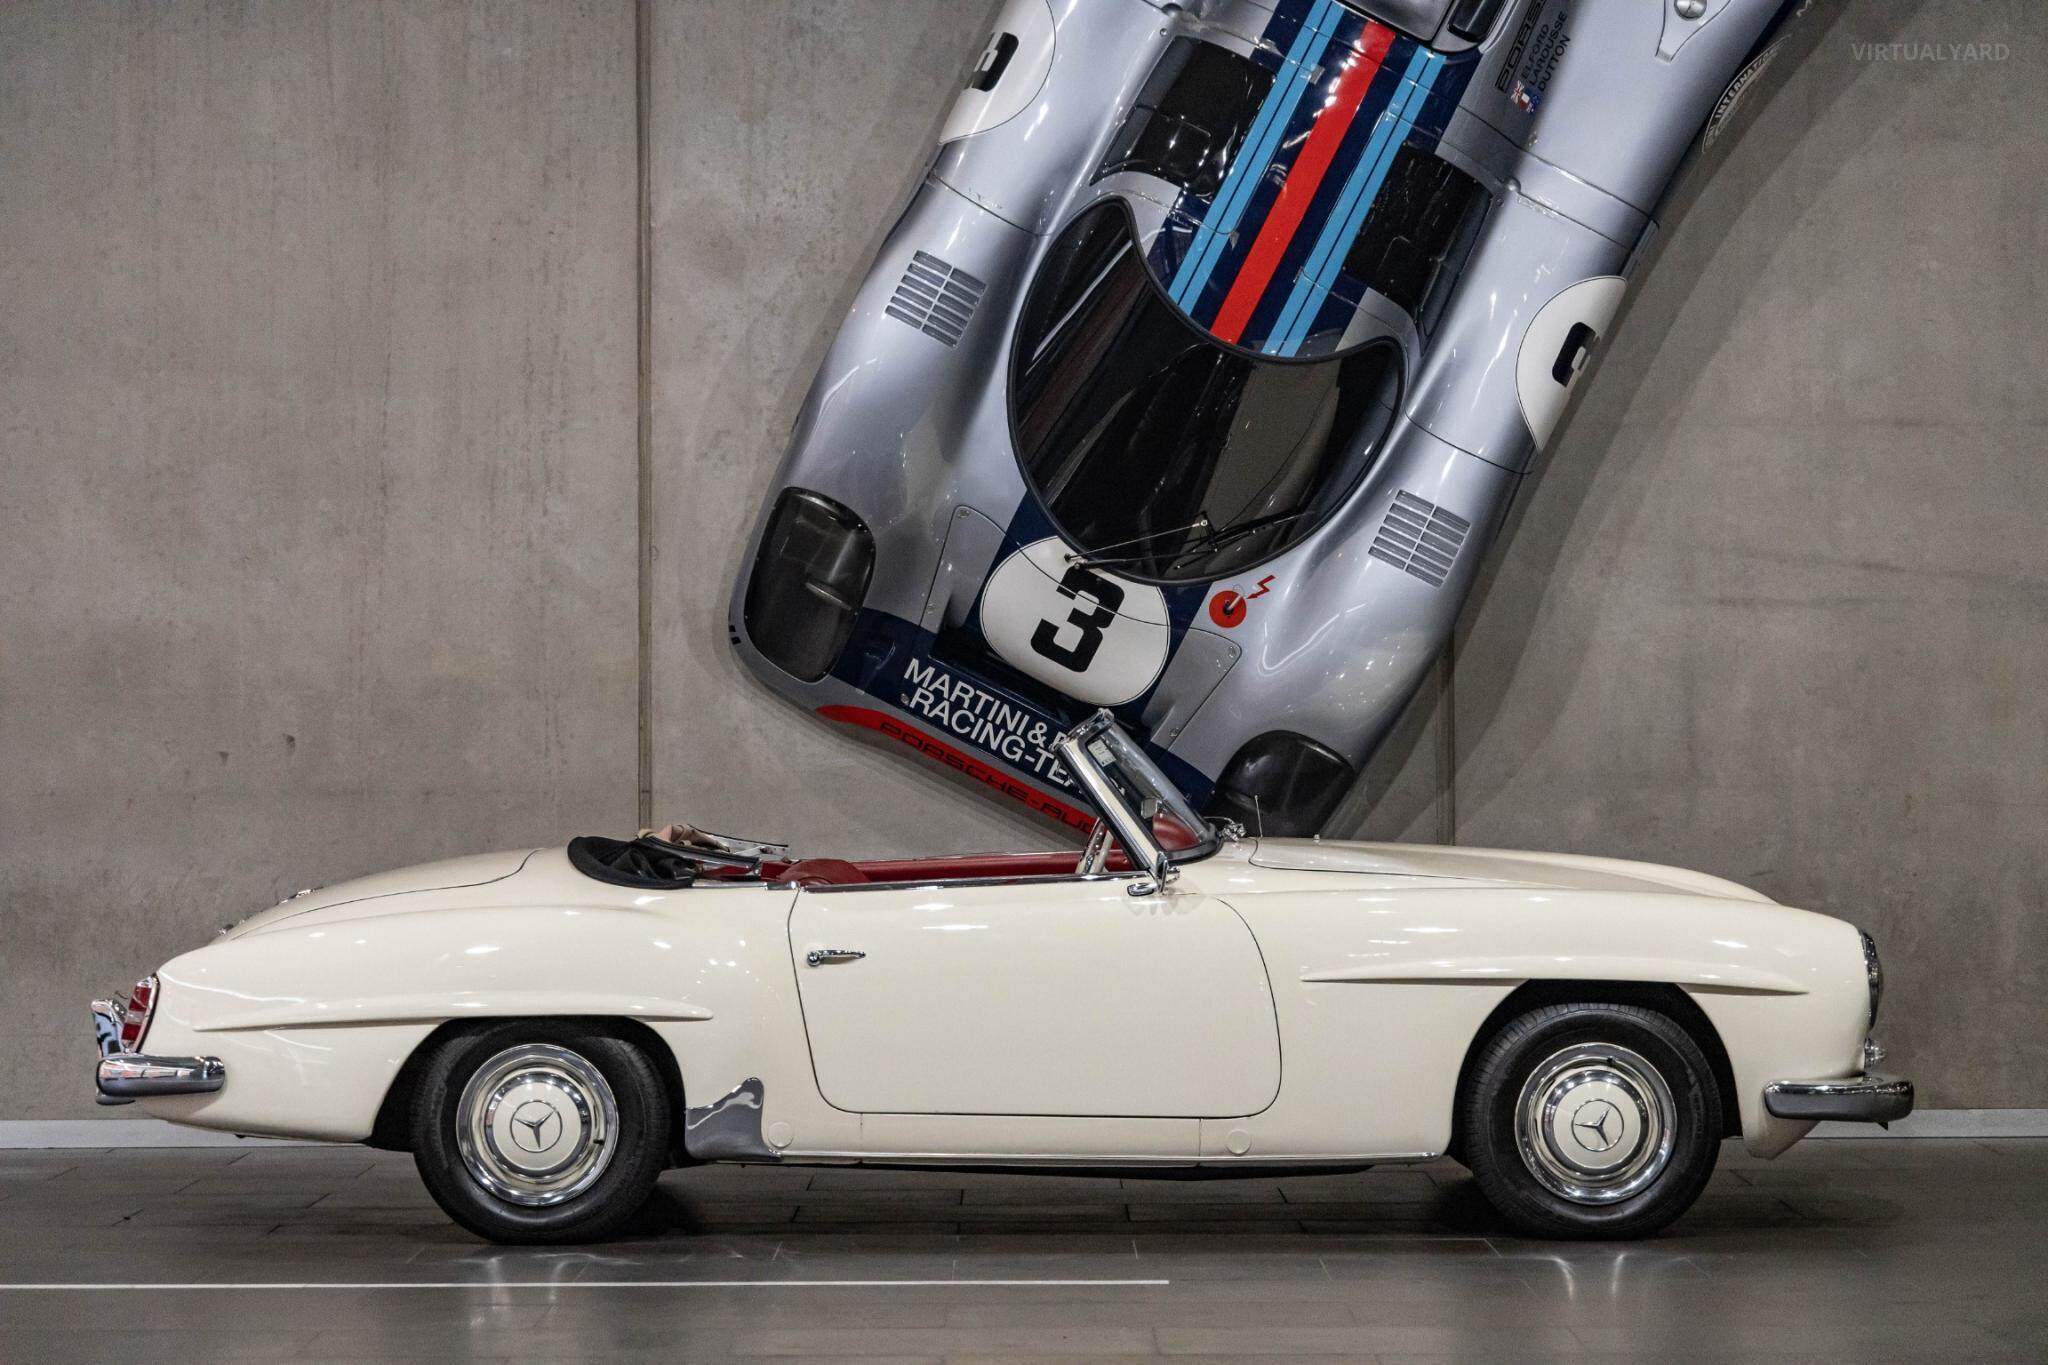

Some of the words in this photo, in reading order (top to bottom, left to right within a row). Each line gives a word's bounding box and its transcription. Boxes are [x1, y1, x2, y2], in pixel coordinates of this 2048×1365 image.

[1496, 0, 1543, 93] PORS
[1521, 23, 1550, 80] ELFORD
[1528, 11, 1568, 87] LAROUSSE
[1537, 34, 1571, 92] DUTTON
[1030, 564, 1125, 673] 3
[903, 657, 1030, 736] MARTINI
[909, 687, 1074, 787] RACING-TE
[880, 721, 1096, 834] PORSCHE-AU
